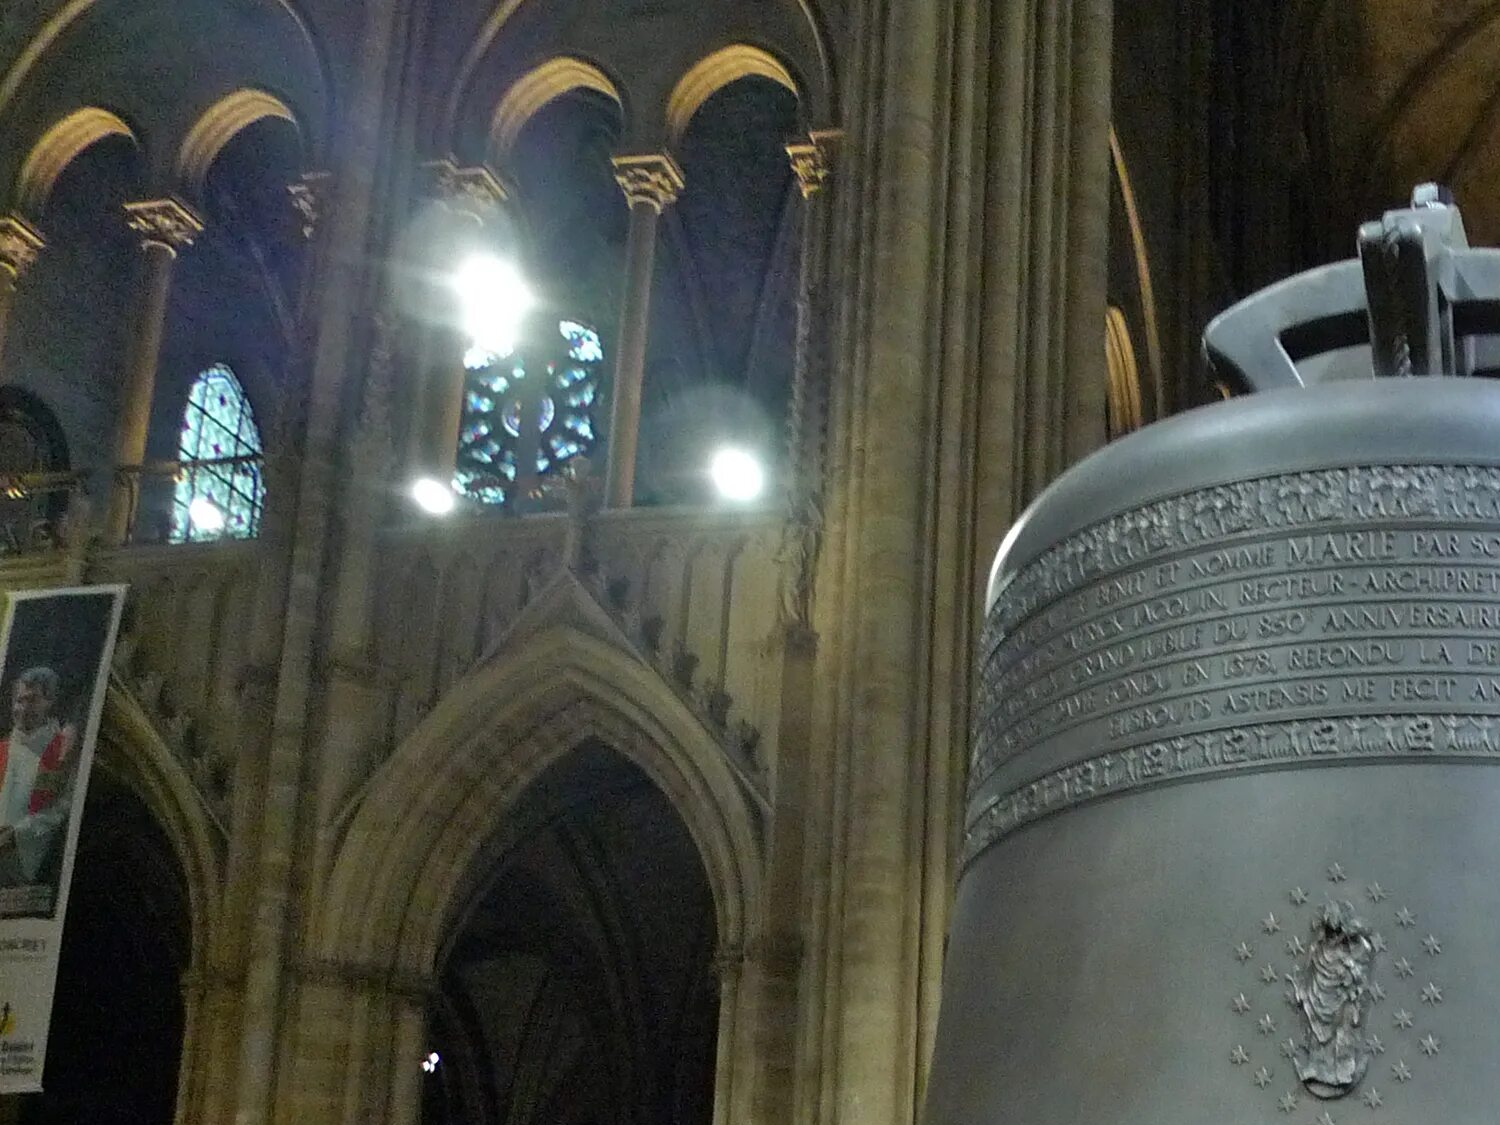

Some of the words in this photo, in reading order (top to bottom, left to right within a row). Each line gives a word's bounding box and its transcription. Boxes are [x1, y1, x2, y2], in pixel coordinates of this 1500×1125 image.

[1157, 561, 1180, 586] ET
[1188, 545, 1275, 581] NOMME
[1287, 531, 1394, 566] MARIE
[1413, 534, 1462, 558] PAR
[1212, 617, 1248, 645] DU
[1288, 641, 1397, 671] REFONDU
[1419, 640, 1453, 664] LA
[1221, 684, 1328, 715] ASTENSIS
[1343, 679, 1376, 701] ME
[1390, 678, 1457, 700] FECIT
